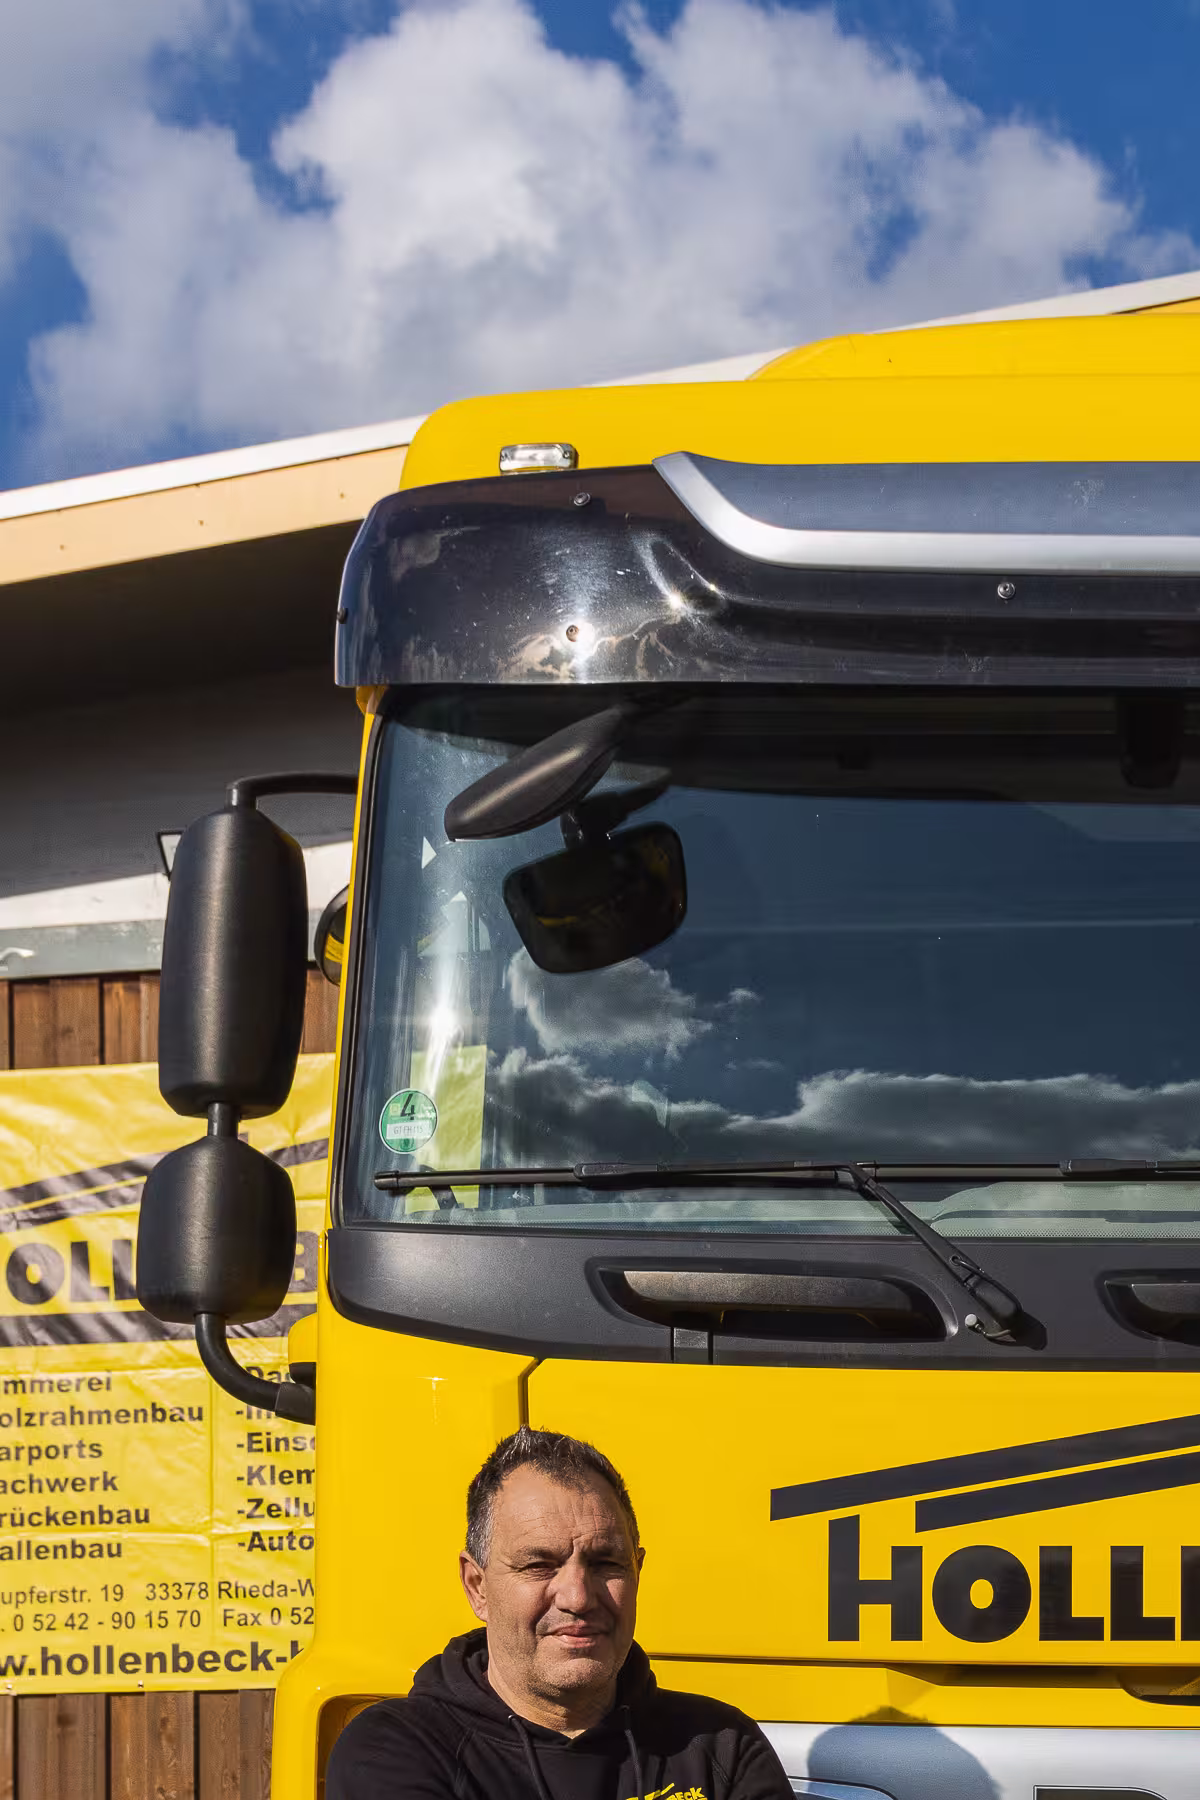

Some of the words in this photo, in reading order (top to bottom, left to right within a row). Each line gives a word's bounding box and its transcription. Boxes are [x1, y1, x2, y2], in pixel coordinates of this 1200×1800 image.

[236, 1432, 315, 1453] -Eins
[101, 1584, 124, 1602] 19
[146, 1582, 209, 1600] 33378
[14, 1614, 24, 1632] 0
[33, 1613, 57, 1631] 52
[64, 1613, 89, 1631] 42
[112, 1612, 135, 1630] 90
[146, 1610, 168, 1629] 15
[178, 1610, 200, 1628] 70
[223, 1608, 261, 1627] Fax
[271, 1607, 282, 1626] 0
[290, 1606, 314, 1625] 52
